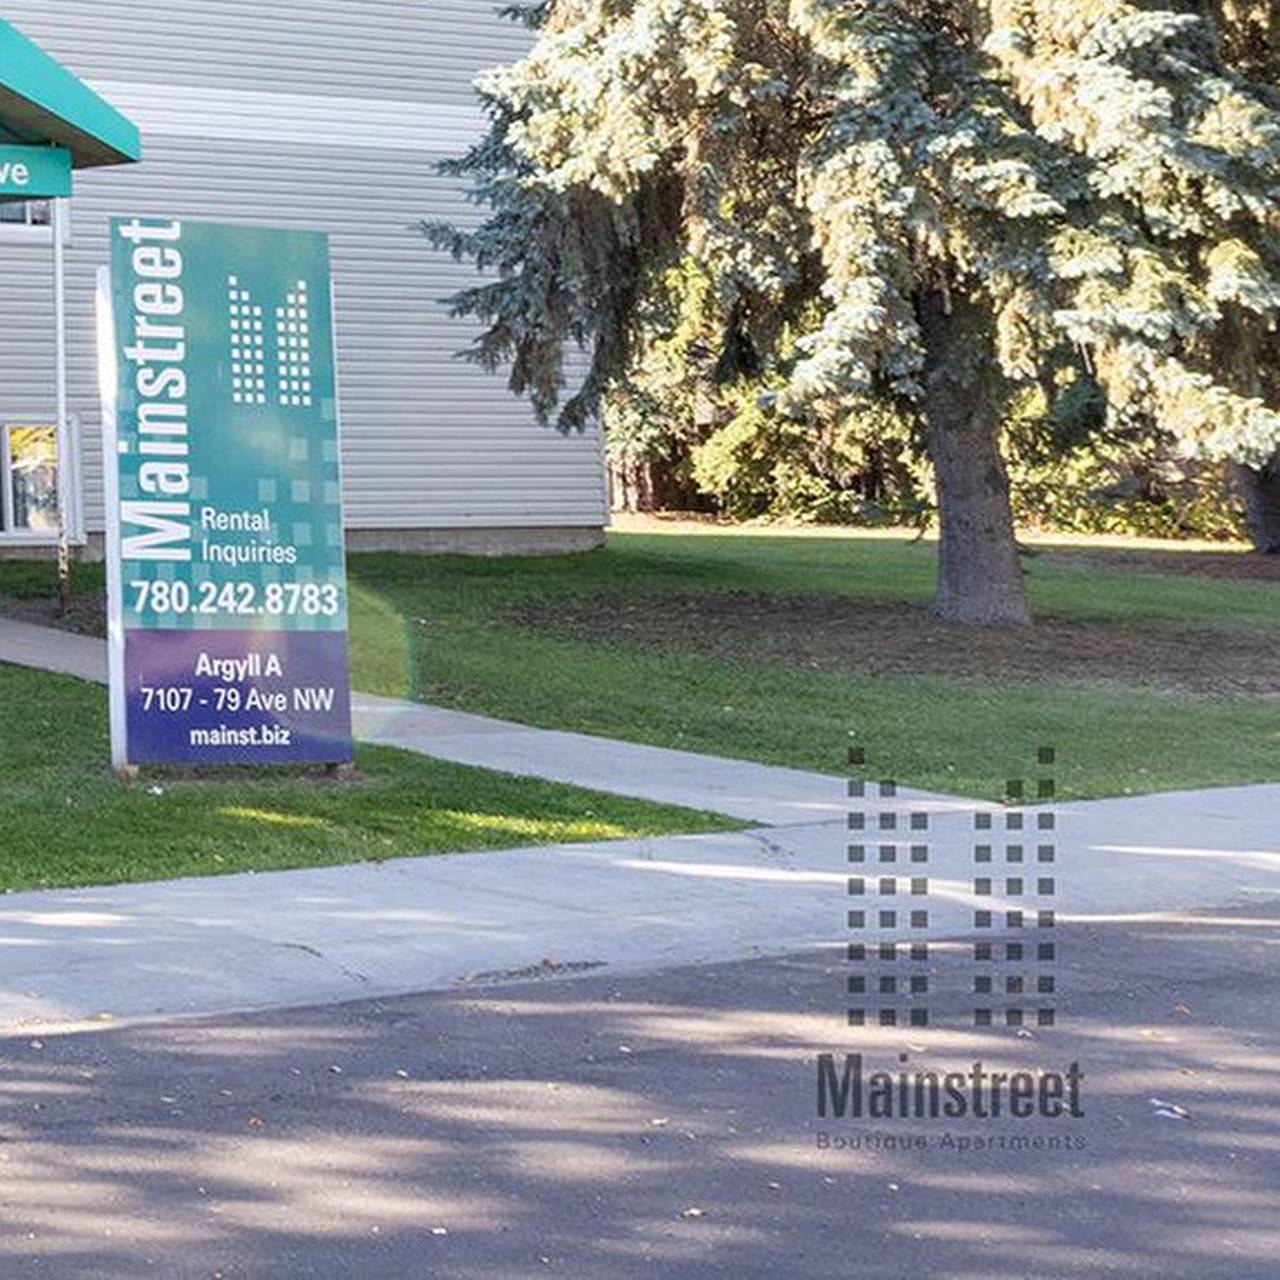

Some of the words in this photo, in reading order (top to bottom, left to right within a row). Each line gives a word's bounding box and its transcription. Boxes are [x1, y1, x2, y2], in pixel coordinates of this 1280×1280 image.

[118, 219, 191, 561] Mainstreet
[201, 507, 270, 531] Rental
[202, 540, 297, 566] Inquiries
[130, 580, 338, 615] 780.242.8783
[195, 652, 261, 681] Argyll
[265, 653, 282, 676] A
[142, 688, 192, 711] 7107
[214, 688, 240, 710] 79
[245, 690, 287, 710] Ave
[294, 688, 334, 711] NW
[190, 724, 290, 745] mainst.biz
